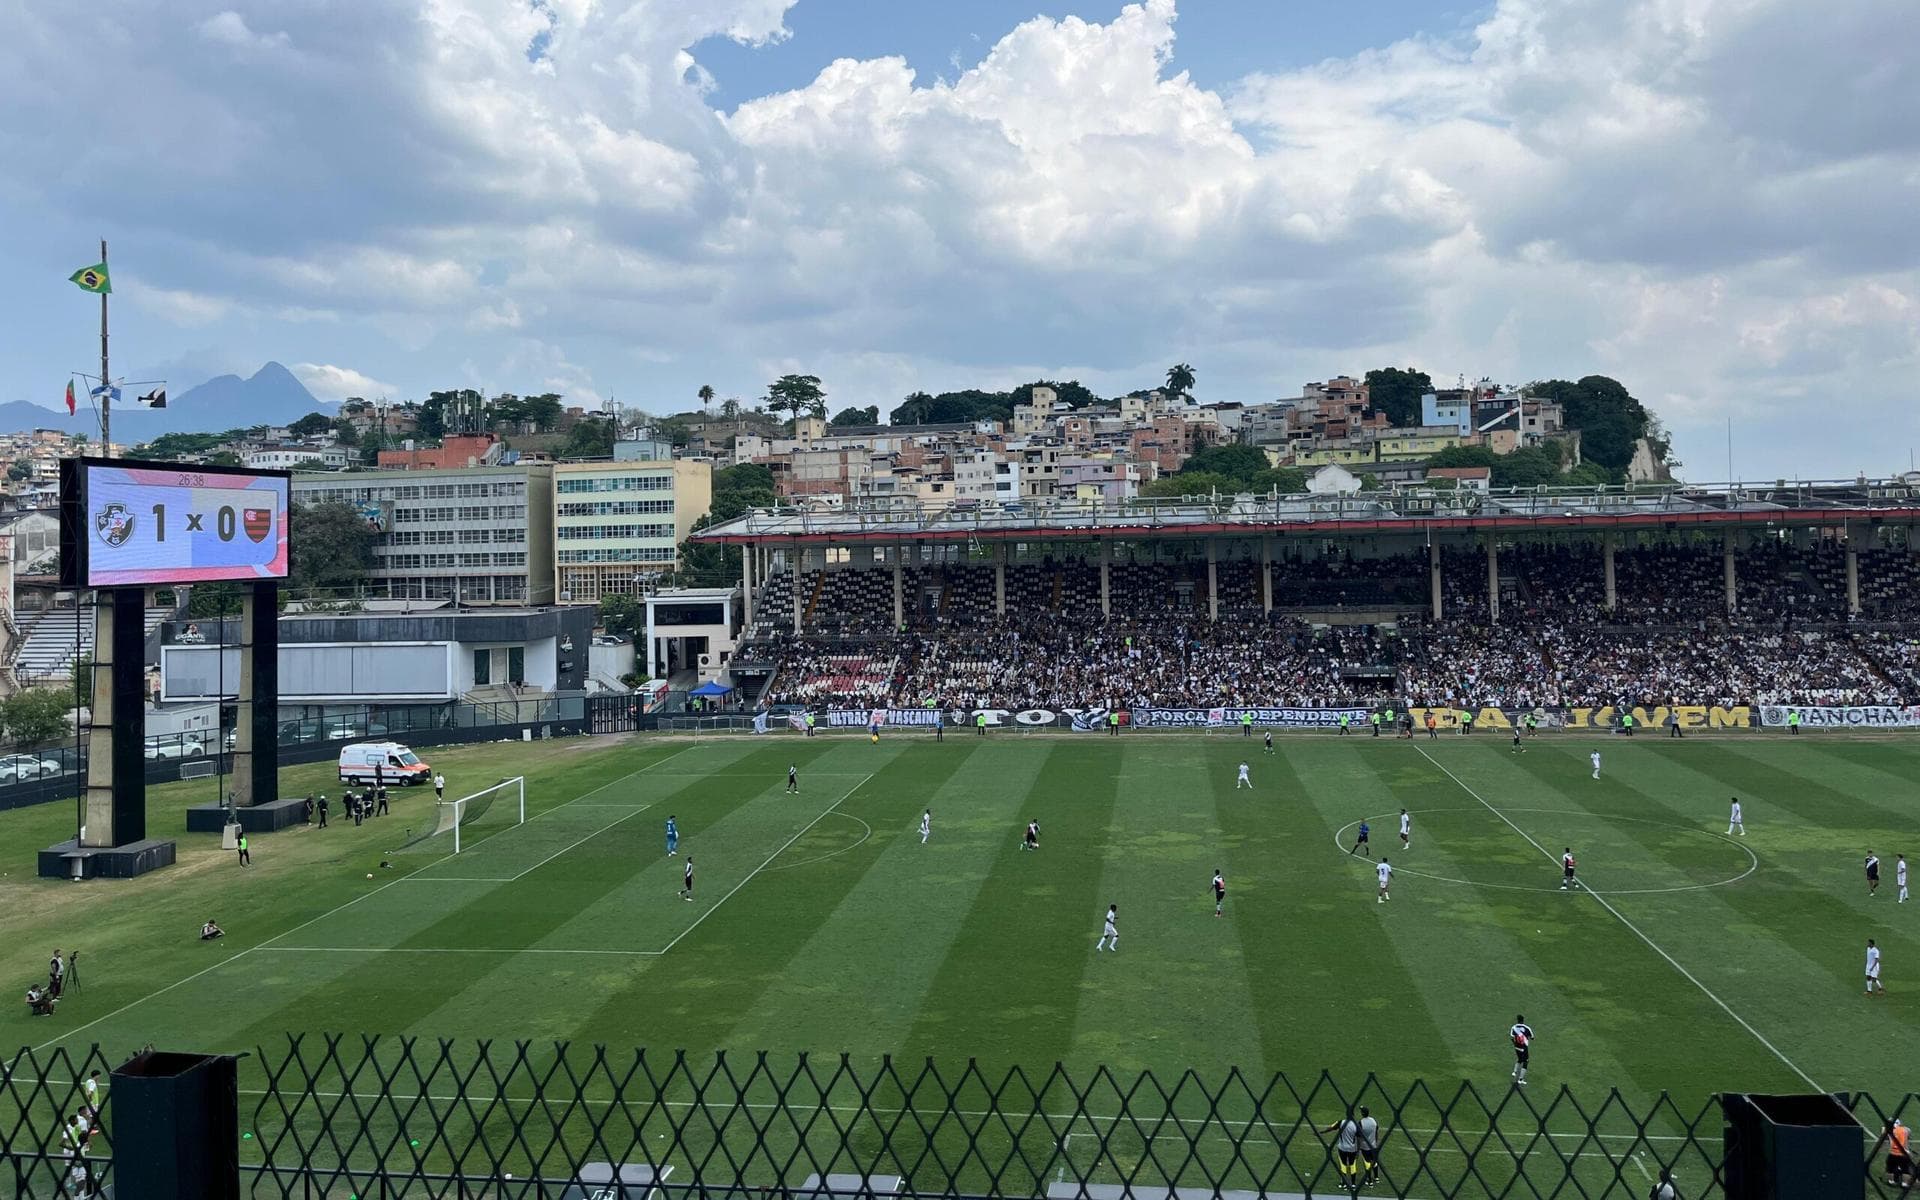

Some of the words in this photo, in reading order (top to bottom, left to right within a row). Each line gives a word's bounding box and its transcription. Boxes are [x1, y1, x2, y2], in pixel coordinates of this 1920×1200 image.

[178, 473, 205, 487] 26:38
[152, 504, 165, 542] 1
[217, 505, 236, 542] 0
[829, 711, 868, 726] ULTRAS
